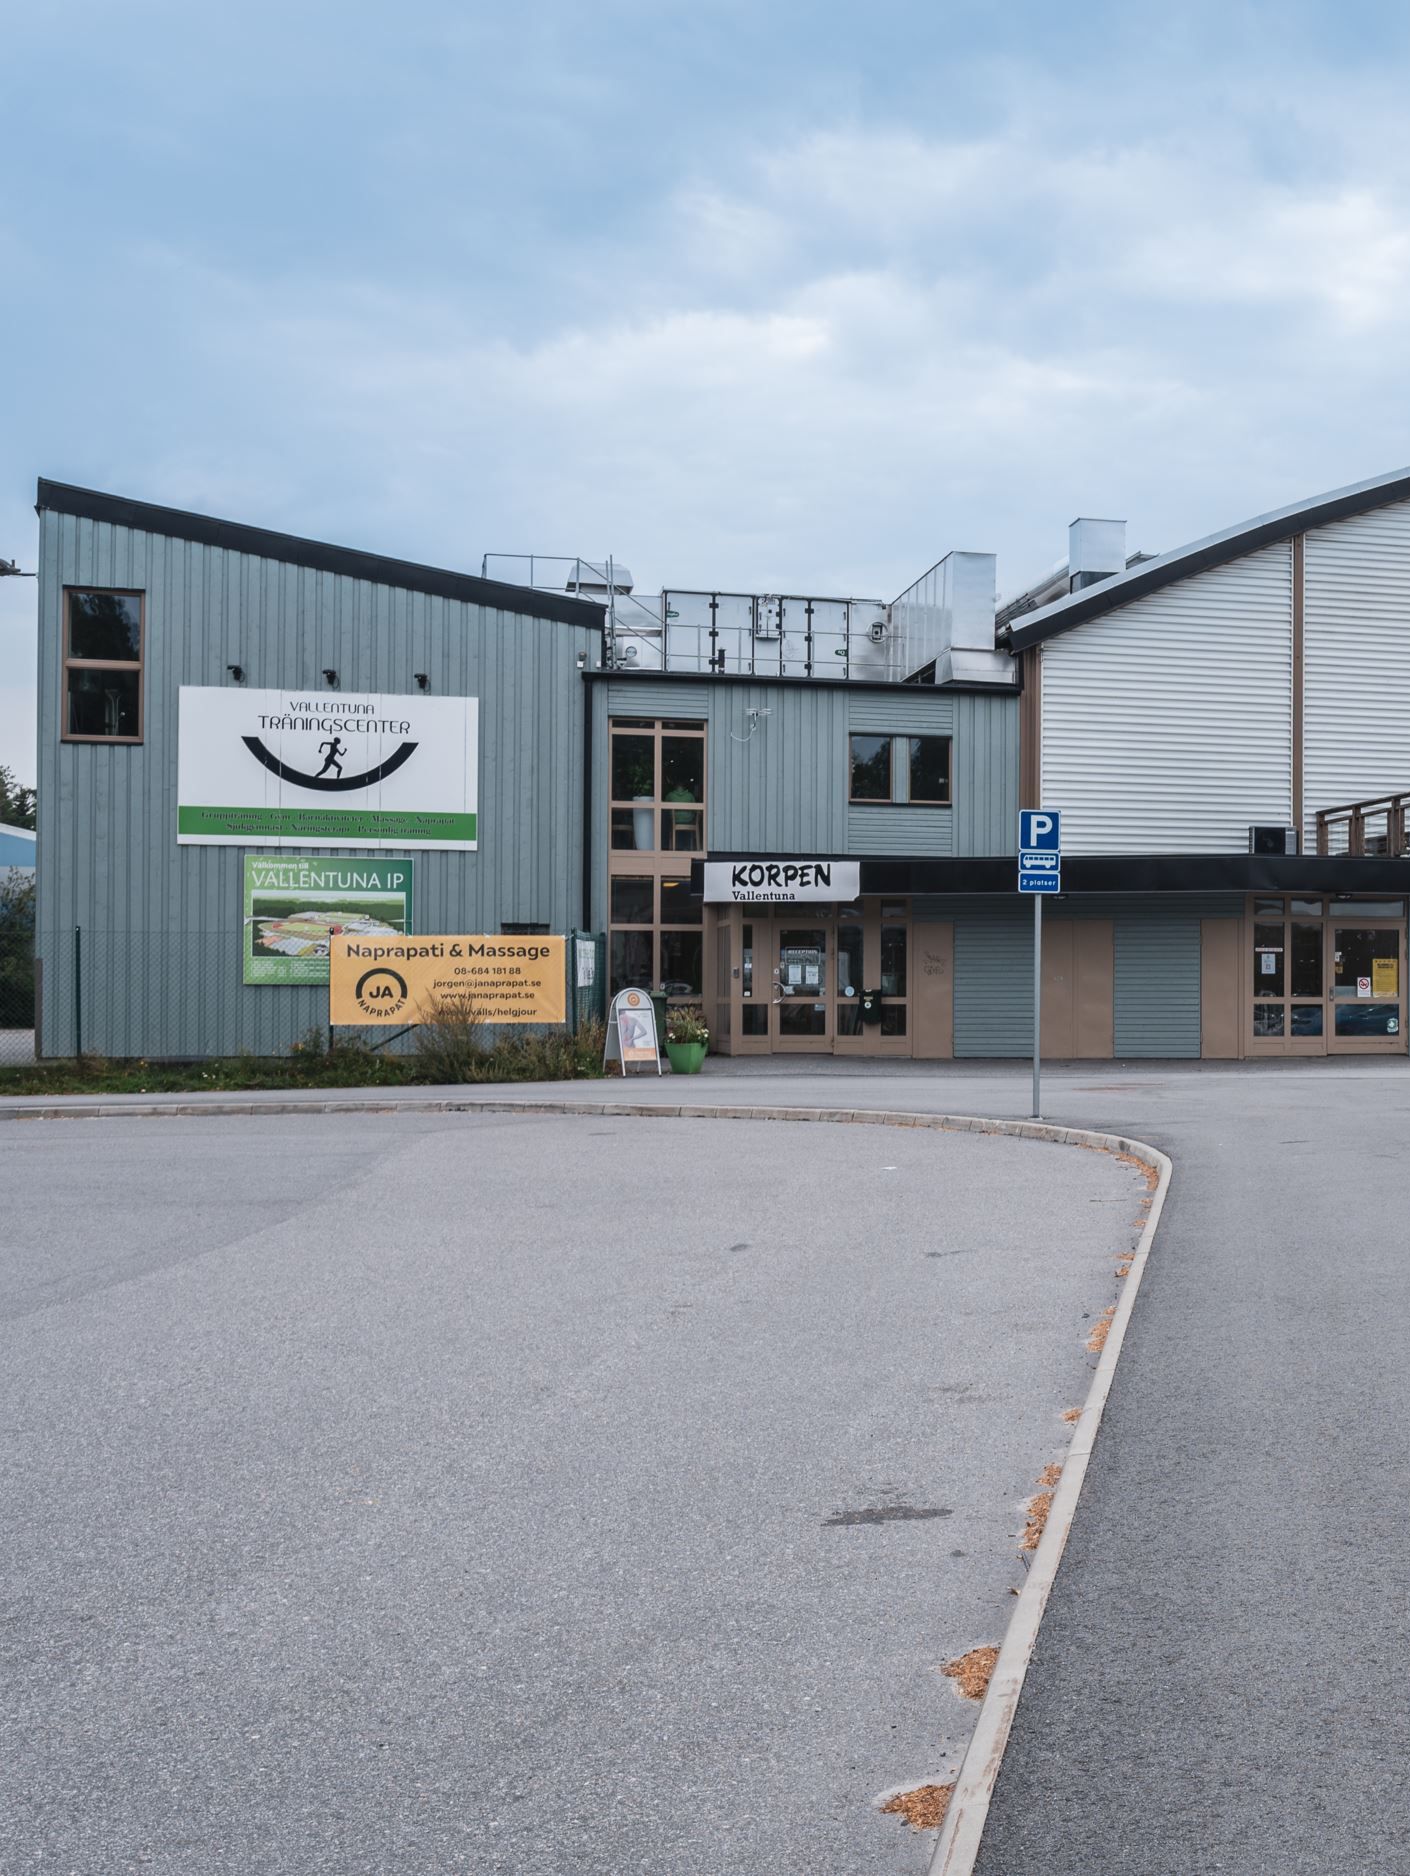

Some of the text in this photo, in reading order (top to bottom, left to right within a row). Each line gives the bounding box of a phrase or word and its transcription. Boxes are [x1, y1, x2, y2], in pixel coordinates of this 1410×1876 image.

[289, 701, 375, 715] VALLENTUNA
[258, 714, 411, 734] TRÄNINGSCENTER
[1030, 814, 1053, 847] P
[252, 871, 404, 889] VALLENTUNA IP
[732, 863, 831, 887] KORPEN
[732, 891, 796, 900] Vallentuna
[347, 943, 550, 961] Naprapati & Massage
[454, 967, 489, 975] 08-684
[369, 985, 393, 999] JA
[433, 980, 541, 989] jorgen@janaprapat.se
[440, 991, 535, 1000] www.janaprapat.se
[358, 999, 405, 1017] NAPRAPAT
